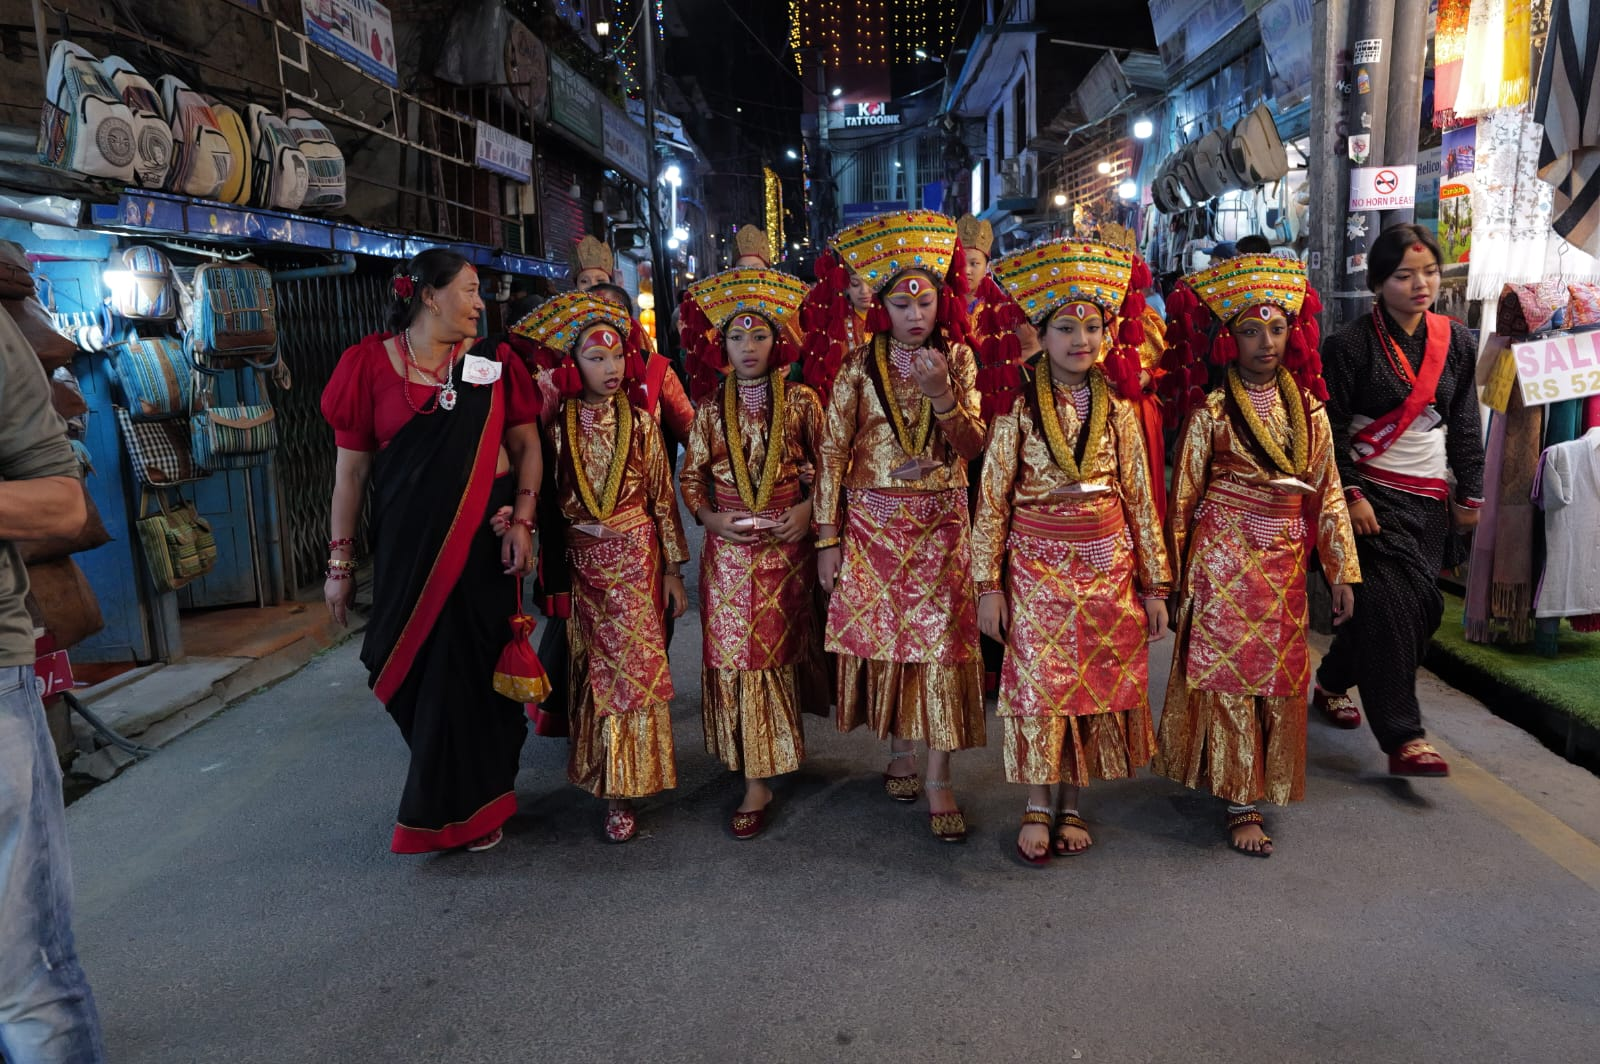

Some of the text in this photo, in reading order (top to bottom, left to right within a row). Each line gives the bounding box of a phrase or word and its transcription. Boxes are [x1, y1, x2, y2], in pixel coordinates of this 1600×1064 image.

[845, 115, 900, 126] TATTOOINK
[1417, 160, 1441, 176] Helico
[1352, 199, 1364, 208] NO
[1366, 197, 1388, 207] HORN
[1523, 379, 1560, 402] RS
